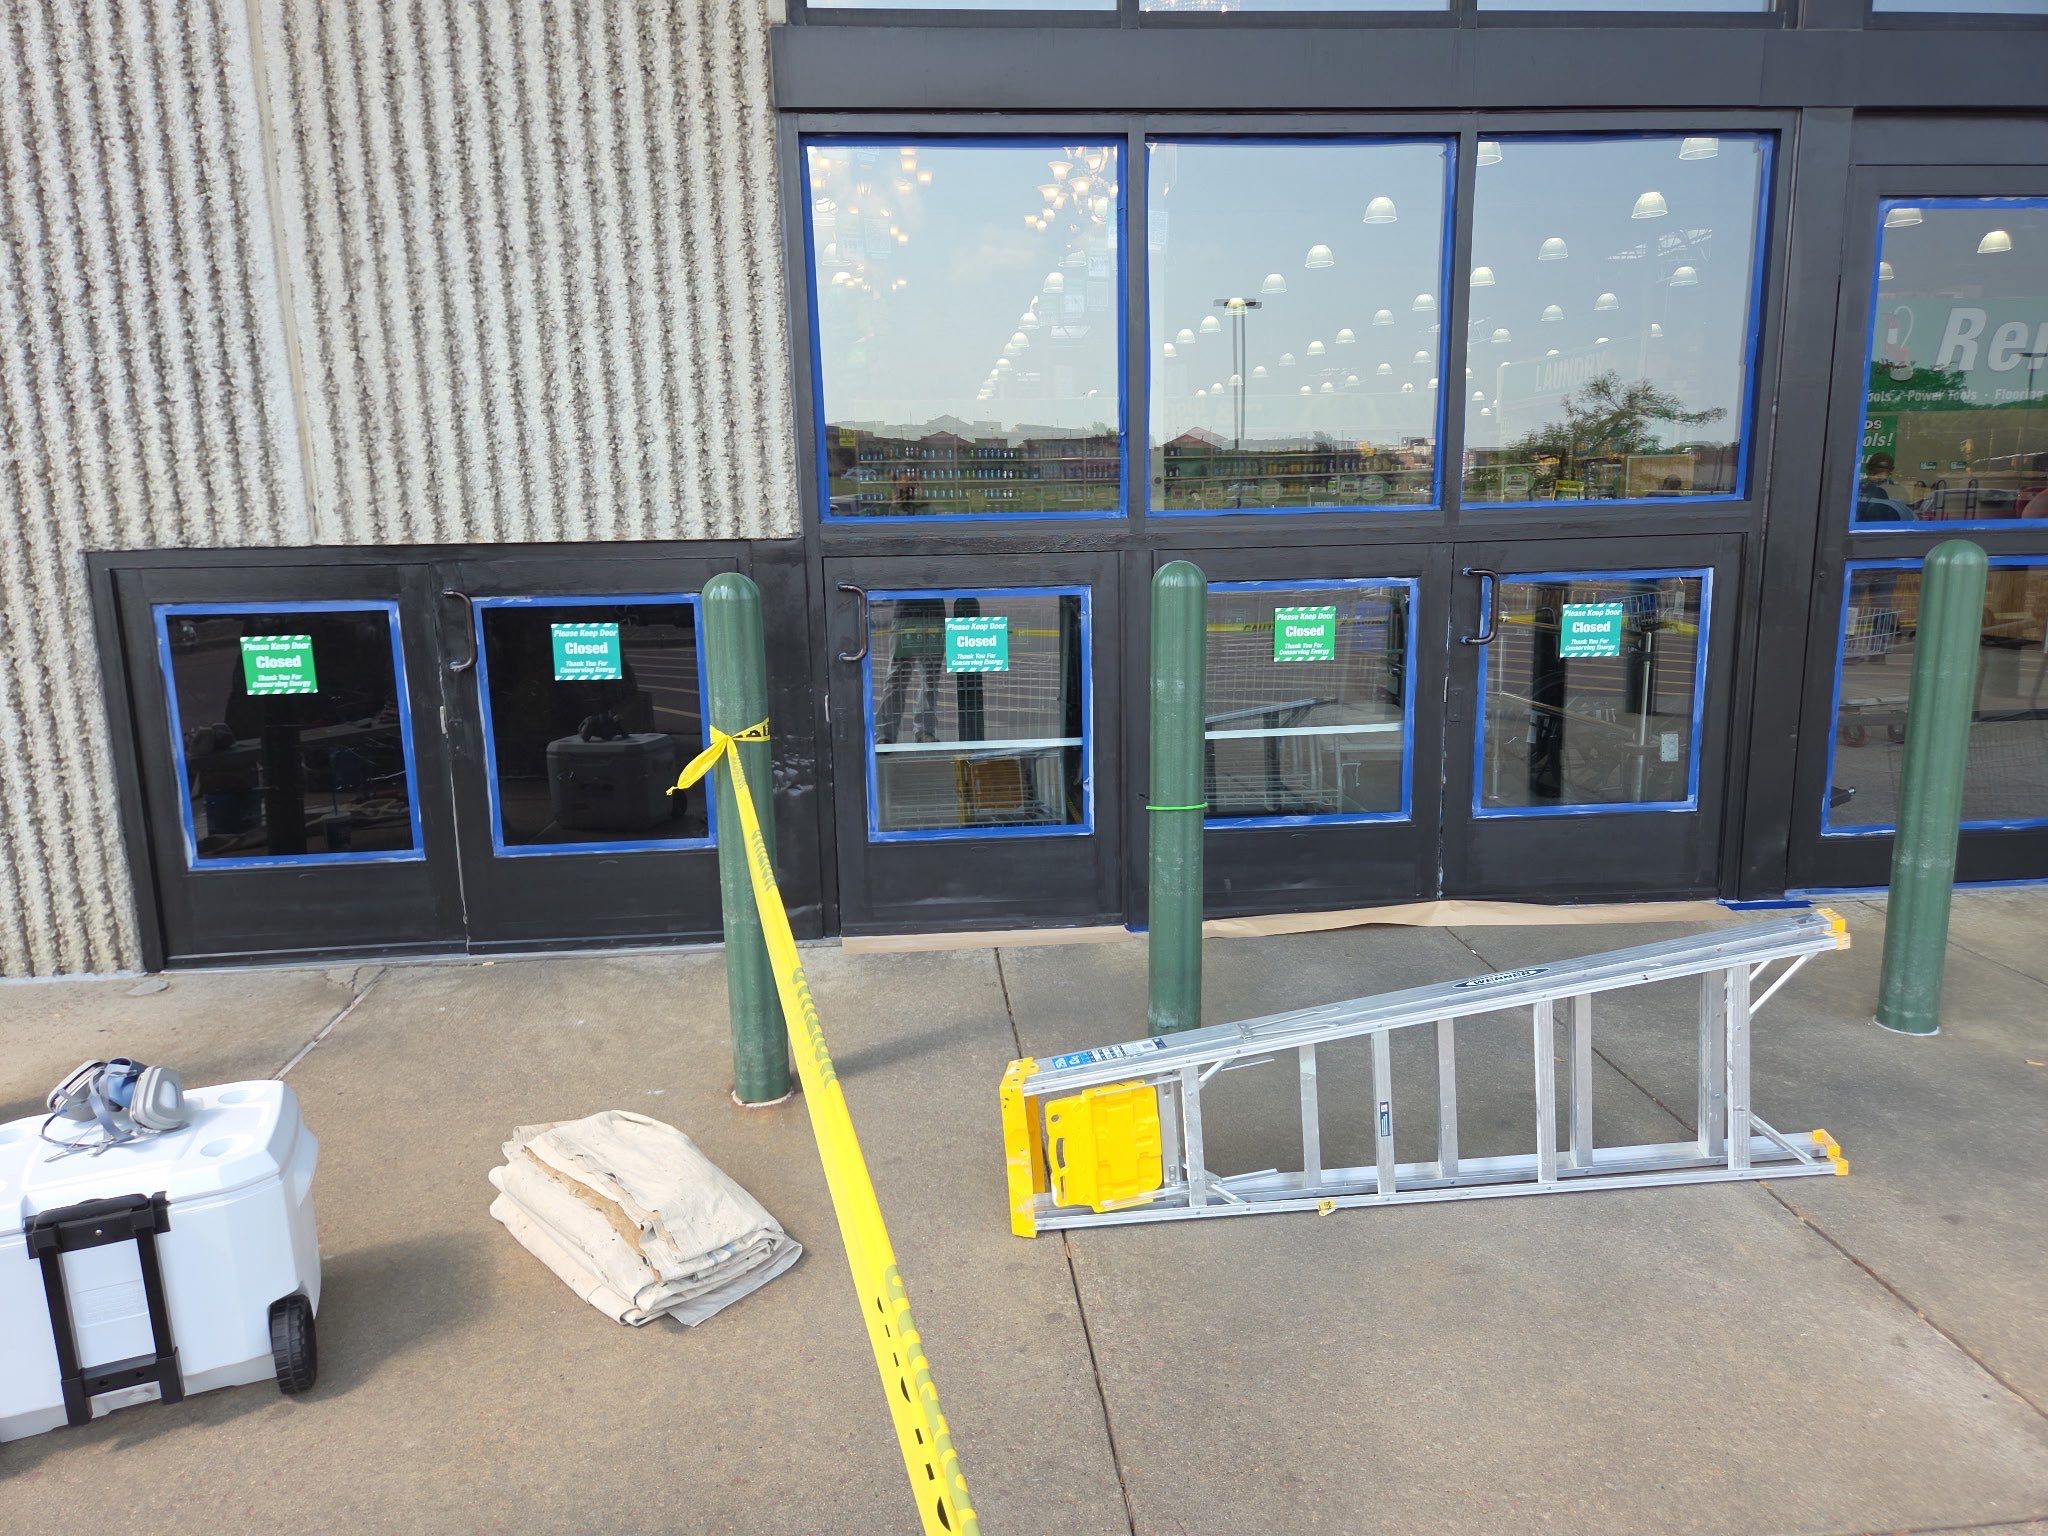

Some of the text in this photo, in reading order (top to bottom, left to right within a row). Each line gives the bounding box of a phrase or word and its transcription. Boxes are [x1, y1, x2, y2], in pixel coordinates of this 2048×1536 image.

[1906, 389, 1944, 402] Power
[1948, 388, 1977, 401] Tools
[1276, 612, 1335, 621] Please Keep Door
[1563, 608, 1622, 617] Please Keep Door
[946, 622, 1007, 632] Please Keep Door
[1285, 624, 1325, 637] Closed
[1572, 620, 1612, 634] Closed
[553, 628, 618, 638] Please Keep Door
[243, 641, 311, 651] Please Keep Door
[956, 634, 997, 648] Closed
[564, 641, 609, 655] Closed
[1564, 644, 1596, 652] Conserving
[255, 654, 302, 669] Closed
[951, 659, 984, 667] Conserving
